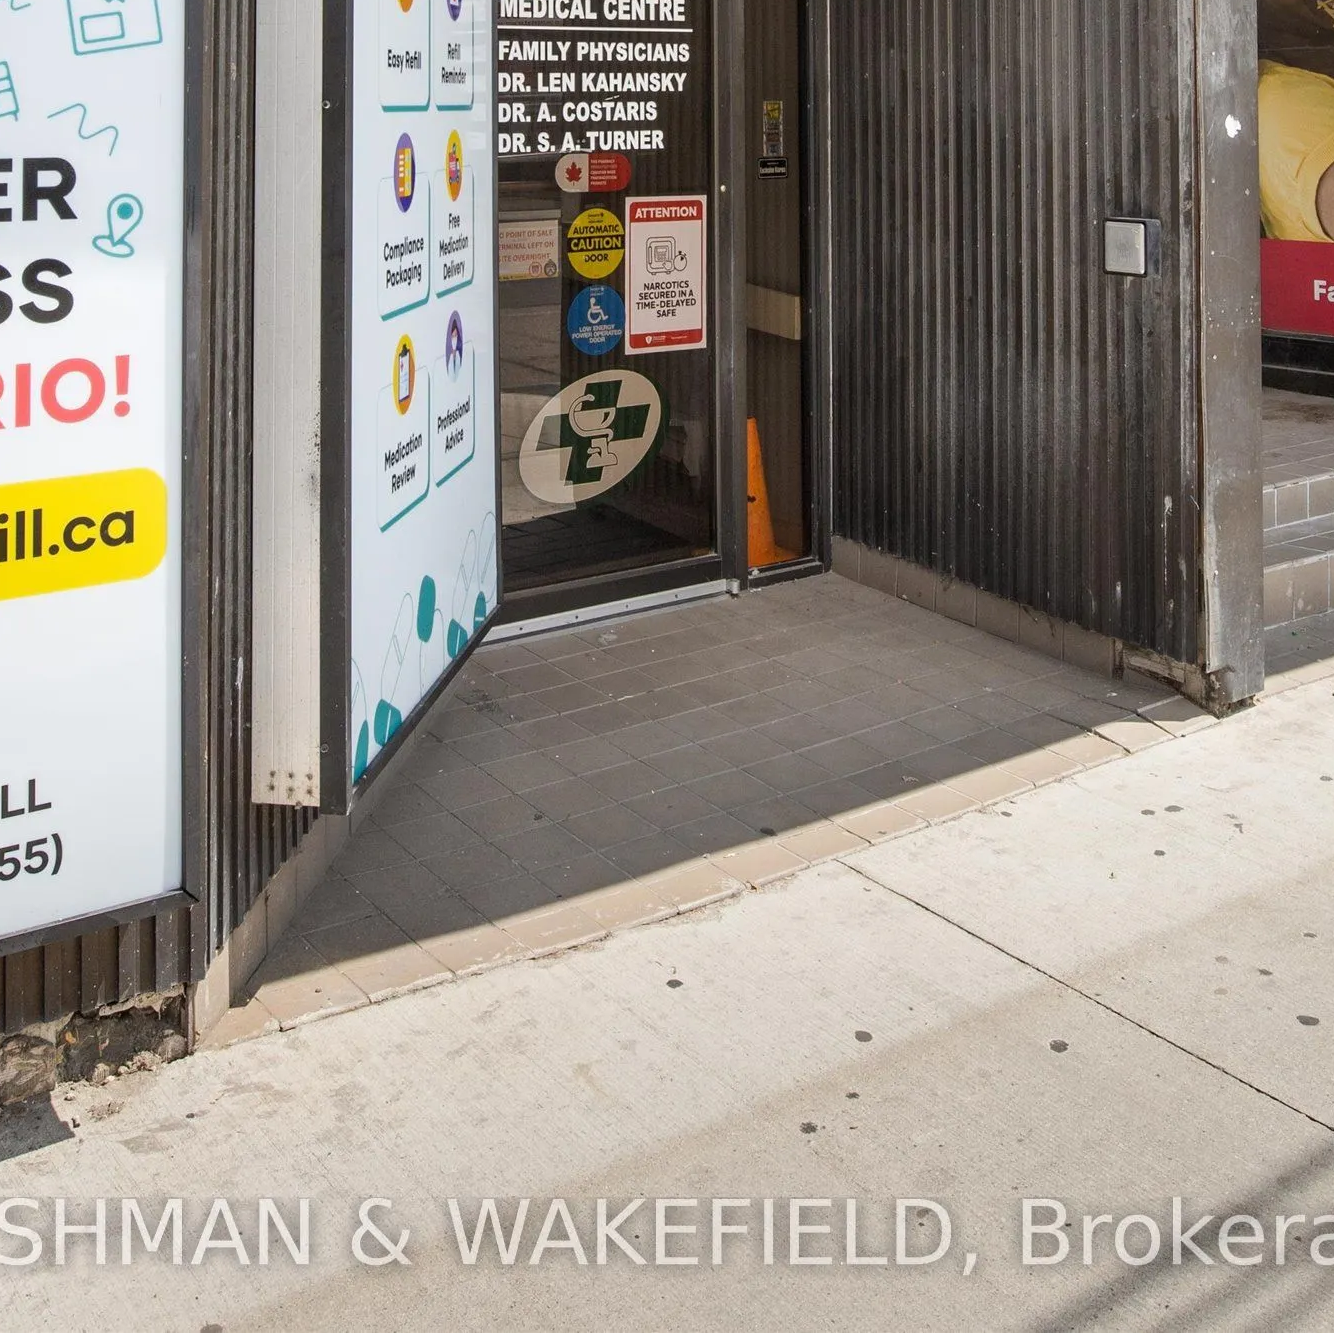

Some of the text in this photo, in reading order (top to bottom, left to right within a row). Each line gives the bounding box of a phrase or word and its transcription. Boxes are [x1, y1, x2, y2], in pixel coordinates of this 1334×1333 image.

[387, 49, 422, 71] Easy Refill
[447, 42, 461, 61] Refill
[498, 41, 690, 62] FAMILY PHYSICIANS
[441, 66, 467, 85] Reminder
[498, 72, 687, 93] DR. LEN KAHANSKY
[498, 101, 657, 123] DR. A. COSTARIS
[498, 130, 664, 153] DR. S. A. TURNER
[448, 213, 460, 229] Free
[635, 206, 697, 219] ATTENTION
[527, 229, 537, 237] OF
[538, 229, 553, 237] SALE
[573, 224, 619, 235] AUTOMATIC
[383, 236, 424, 262] Compliance
[439, 233, 469, 257] Medication
[527, 241, 543, 249] LEFT
[570, 236, 621, 251] CAUTION
[512, 252, 551, 263] OVERNIGHT
[584, 254, 609, 263] DOOR
[385, 262, 422, 290] Packaging
[443, 259, 466, 282] Delivery
[639, 291, 676, 301] SECURED
[688, 289, 694, 297] A
[643, 280, 689, 291] NARCOTICS
[636, 298, 696, 310] TIME-DELAYED
[656, 308, 676, 318] SAFE
[593, 329, 622, 337] OPERATED
[437, 394, 471, 435] Professional
[444, 427, 464, 454] Advice
[384, 431, 423, 471] Medication
[391, 465, 416, 494] Review
